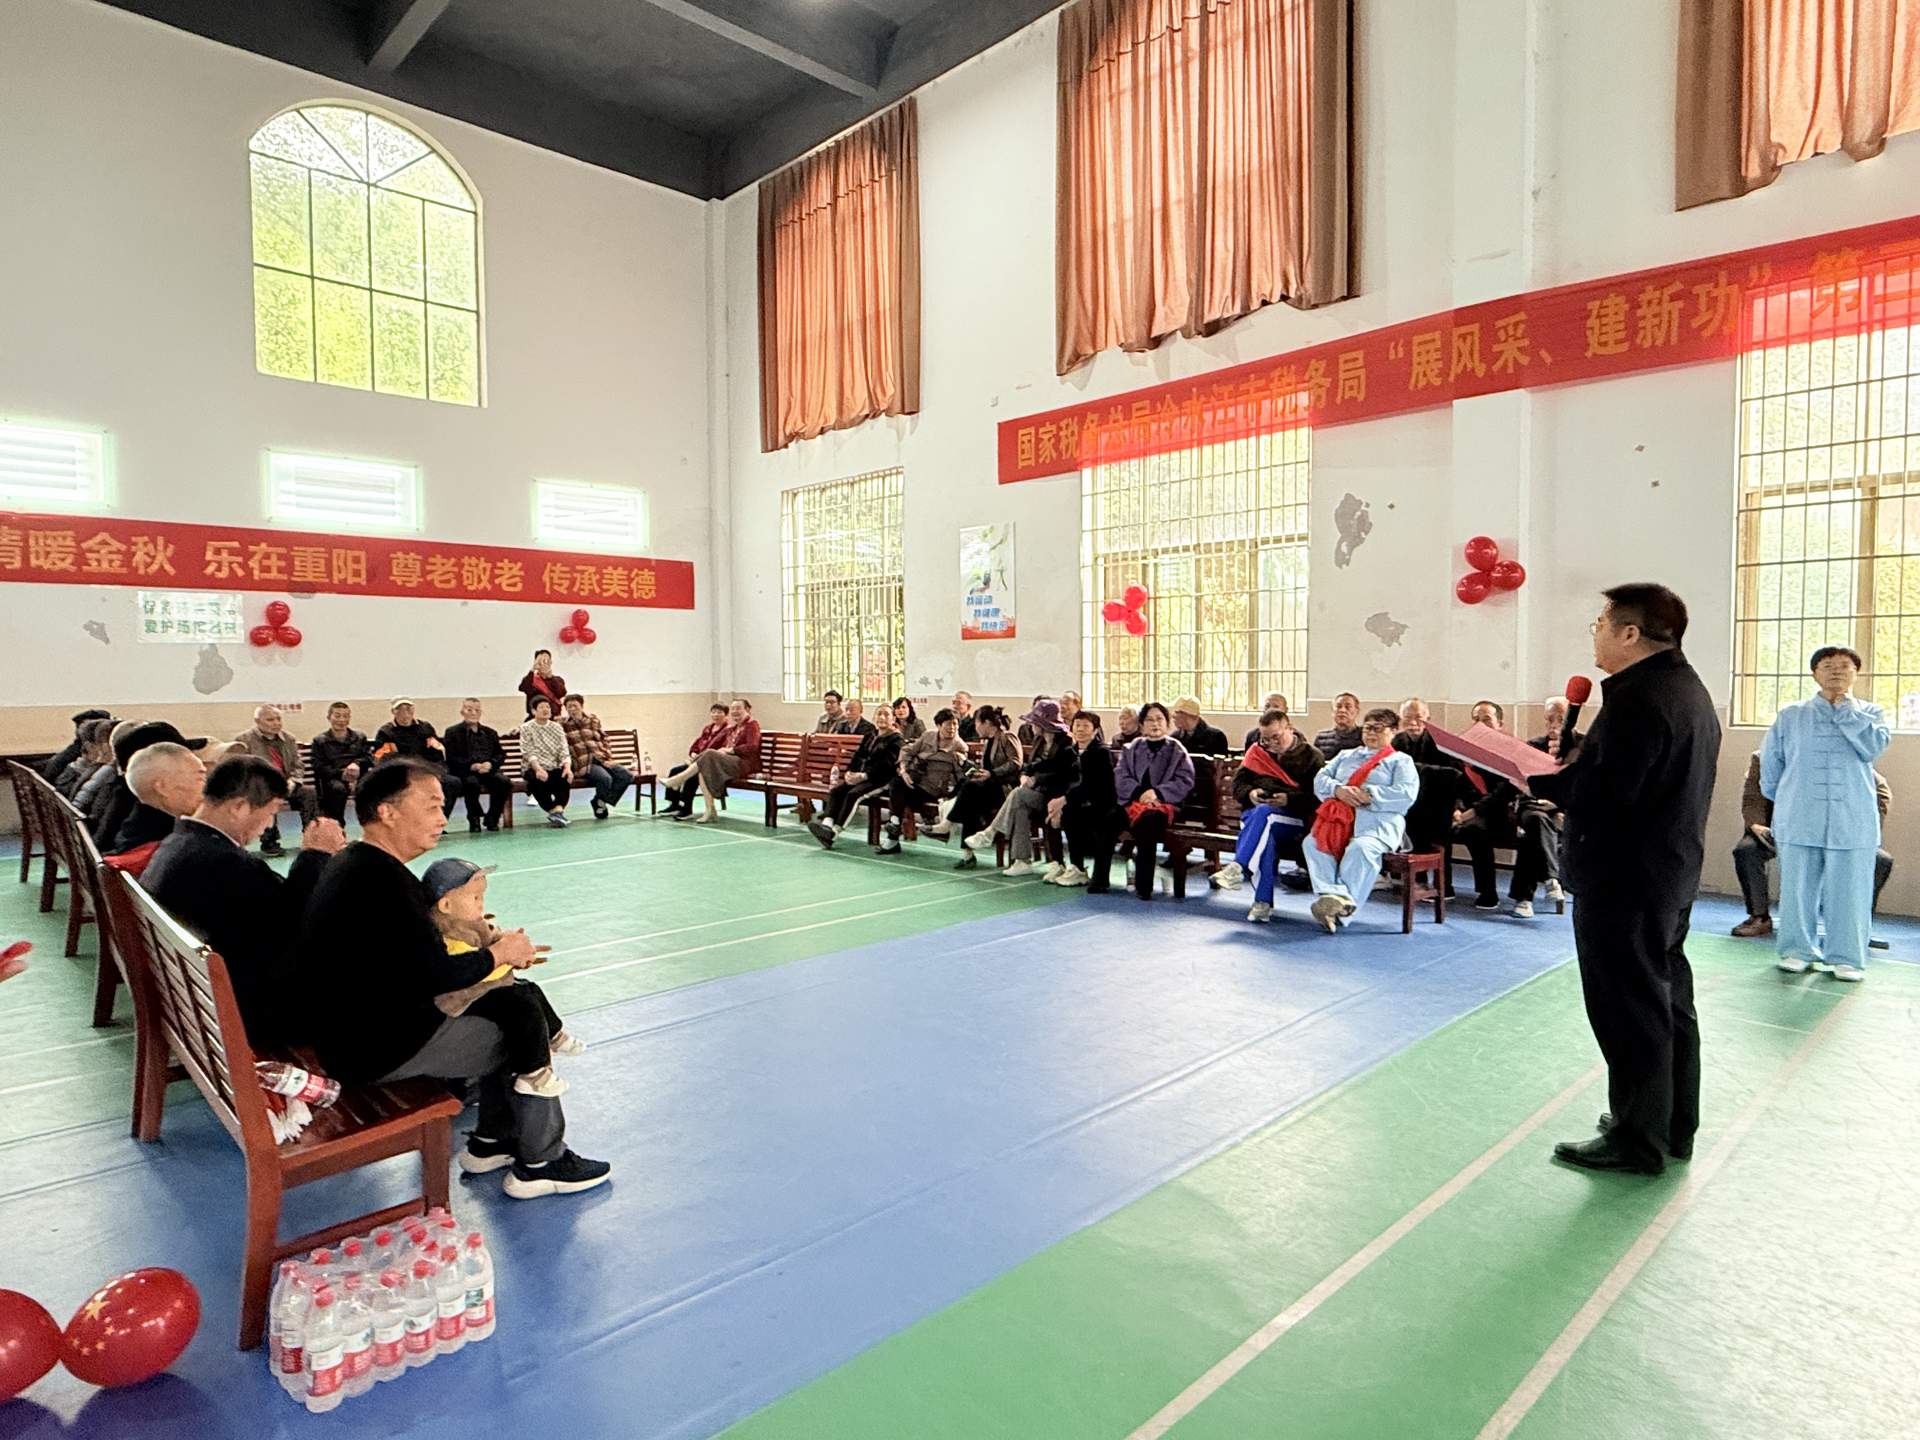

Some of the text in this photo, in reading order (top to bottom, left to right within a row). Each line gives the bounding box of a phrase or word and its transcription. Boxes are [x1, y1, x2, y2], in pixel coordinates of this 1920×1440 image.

[203, 541, 367, 585] 乐在重阳
[389, 551, 524, 592] 尊老敬老
[542, 562, 656, 599] 传承美德
